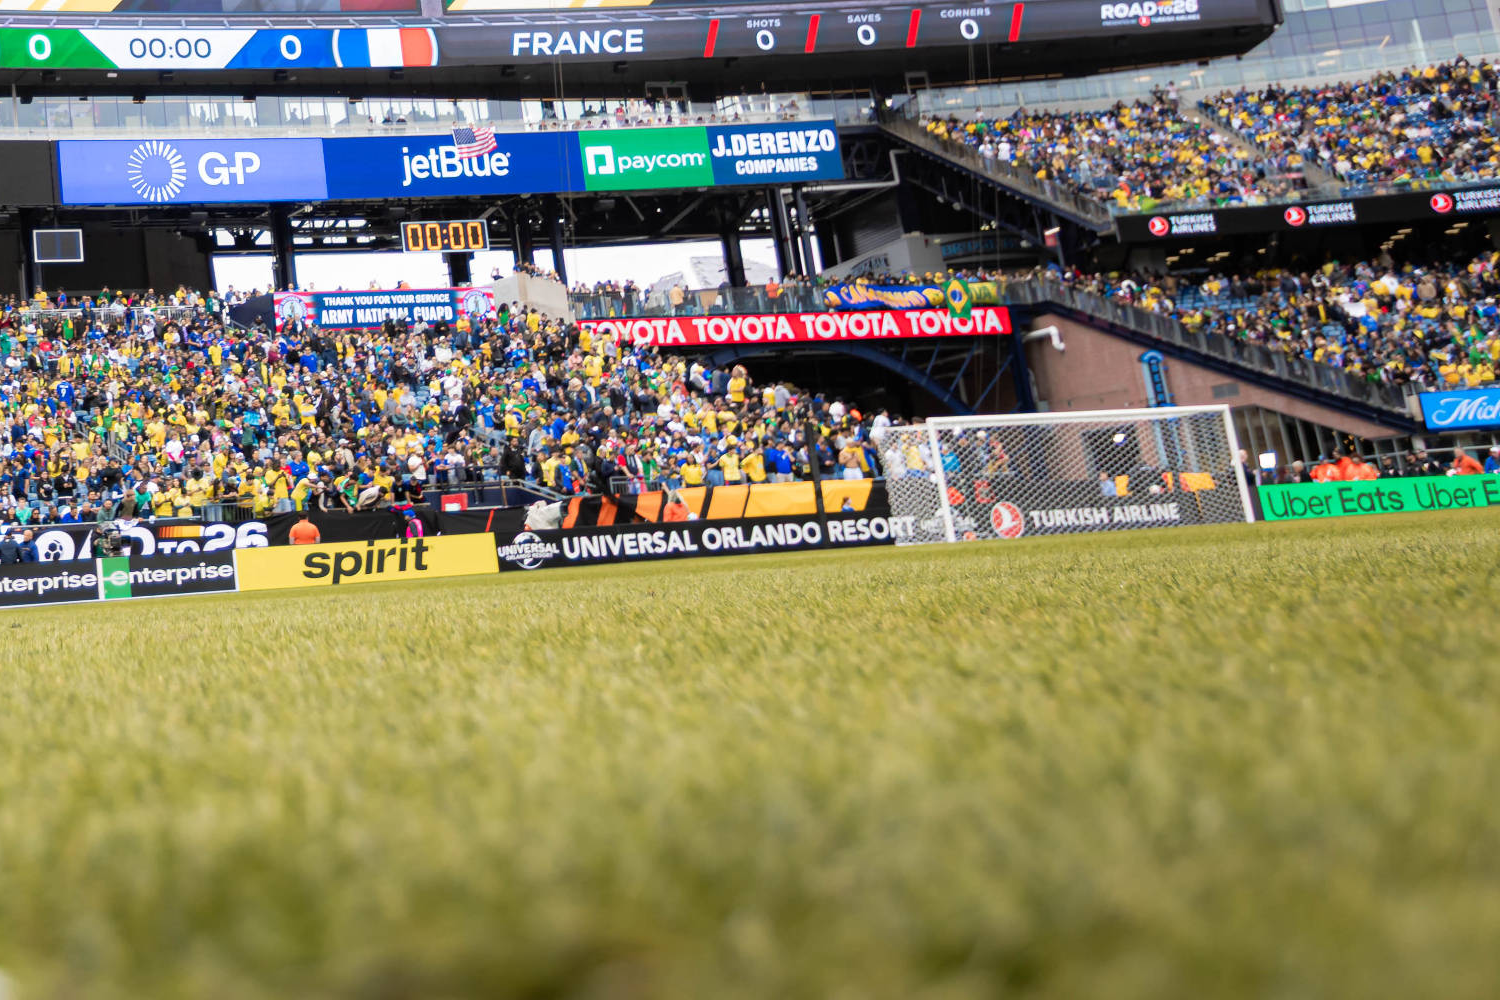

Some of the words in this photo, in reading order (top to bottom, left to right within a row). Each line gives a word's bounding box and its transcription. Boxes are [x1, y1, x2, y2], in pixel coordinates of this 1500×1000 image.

[847, 13, 882, 24] SAVES
[940, 7, 991, 18] CORNERS
[1101, 1, 1157, 20] ROAD
[746, 18, 781, 29] SHOTS
[960, 19, 979, 40] 0
[512, 29, 644, 57] FRANCE
[756, 30, 775, 50] 0
[857, 25, 875, 46] 0
[28, 34, 51, 60] 0
[129, 38, 211, 60] 00:00
[280, 34, 301, 60] 0
[402, 145, 510, 186] jetBlue
[618, 150, 704, 174] paycom
[735, 156, 818, 175] COMPANIES
[1169, 213, 1214, 225] TURKISH
[1307, 202, 1354, 215] TURKISH
[1309, 212, 1356, 224] AIRLINES
[407, 222, 483, 251] 00:00
[1172, 222, 1217, 234] AIRLINES
[323, 297, 354, 306] THANK
[355, 296, 373, 305] YOU
[374, 295, 390, 305] FOR
[390, 295, 414, 304] YOUR
[415, 294, 450, 303] SERVICE
[321, 309, 355, 325] ARMY
[692, 316, 795, 341] TOYOTA
[800, 312, 900, 338] TOYOTA
[1267, 490, 1332, 517] Uber
[1338, 487, 1404, 512] Eats
[1414, 483, 1476, 509] Uber
[1029, 507, 1109, 528] TURKISH
[562, 530, 698, 560] UNIVERSAL
[702, 521, 822, 550] ORLANDO
[829, 516, 915, 542] RESORT
[497, 543, 560, 557] UNIVERSAL
[303, 539, 429, 584] spirit
[109, 563, 234, 586] enterprise
